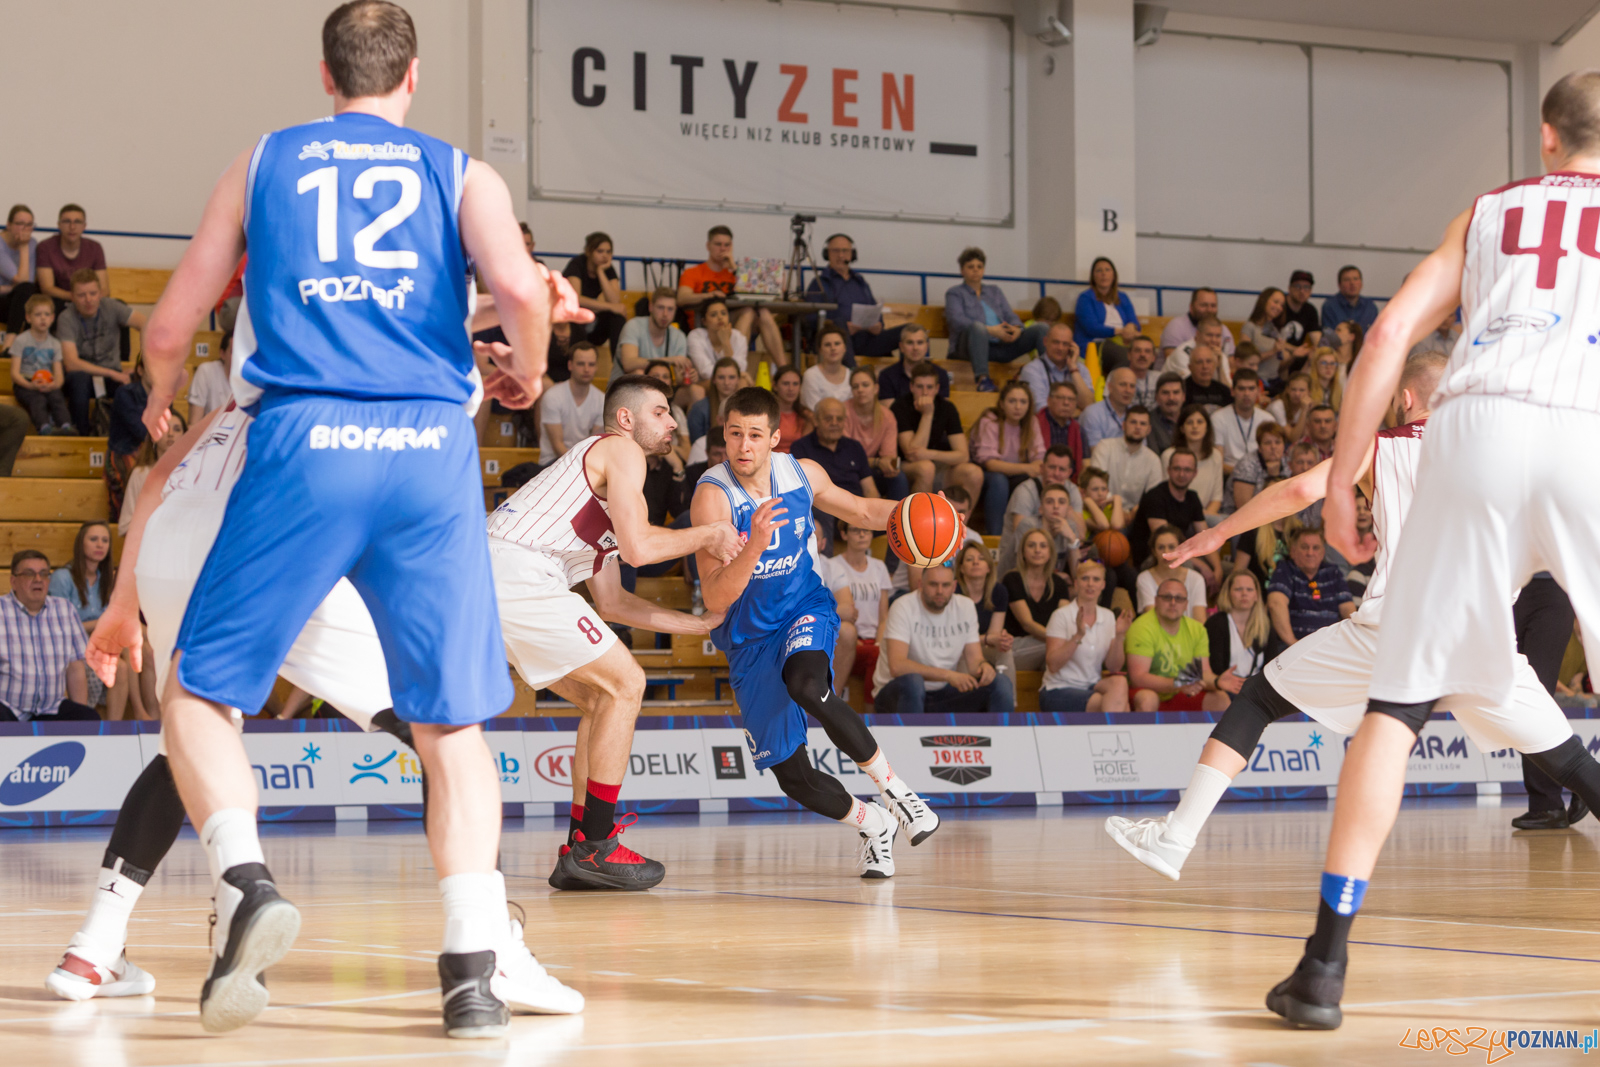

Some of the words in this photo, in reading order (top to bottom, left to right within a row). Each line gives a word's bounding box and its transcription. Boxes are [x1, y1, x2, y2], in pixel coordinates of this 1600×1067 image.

[571, 46, 915, 131] CITYZEN
[680, 121, 737, 140] WIĘCEJ
[782, 129, 822, 145] KLUB
[831, 133, 915, 152] SPORTOWY
[297, 166, 422, 269] 12
[1102, 208, 1119, 232] B
[93, 454, 102, 464] 11
[577, 616, 602, 645] 8
[933, 736, 978, 745] SECURITY
[630, 752, 700, 776] DELIK
[933, 750, 984, 765] JOKER
[1093, 760, 1138, 776] HOTEL
[9, 762, 70, 783] atrem
